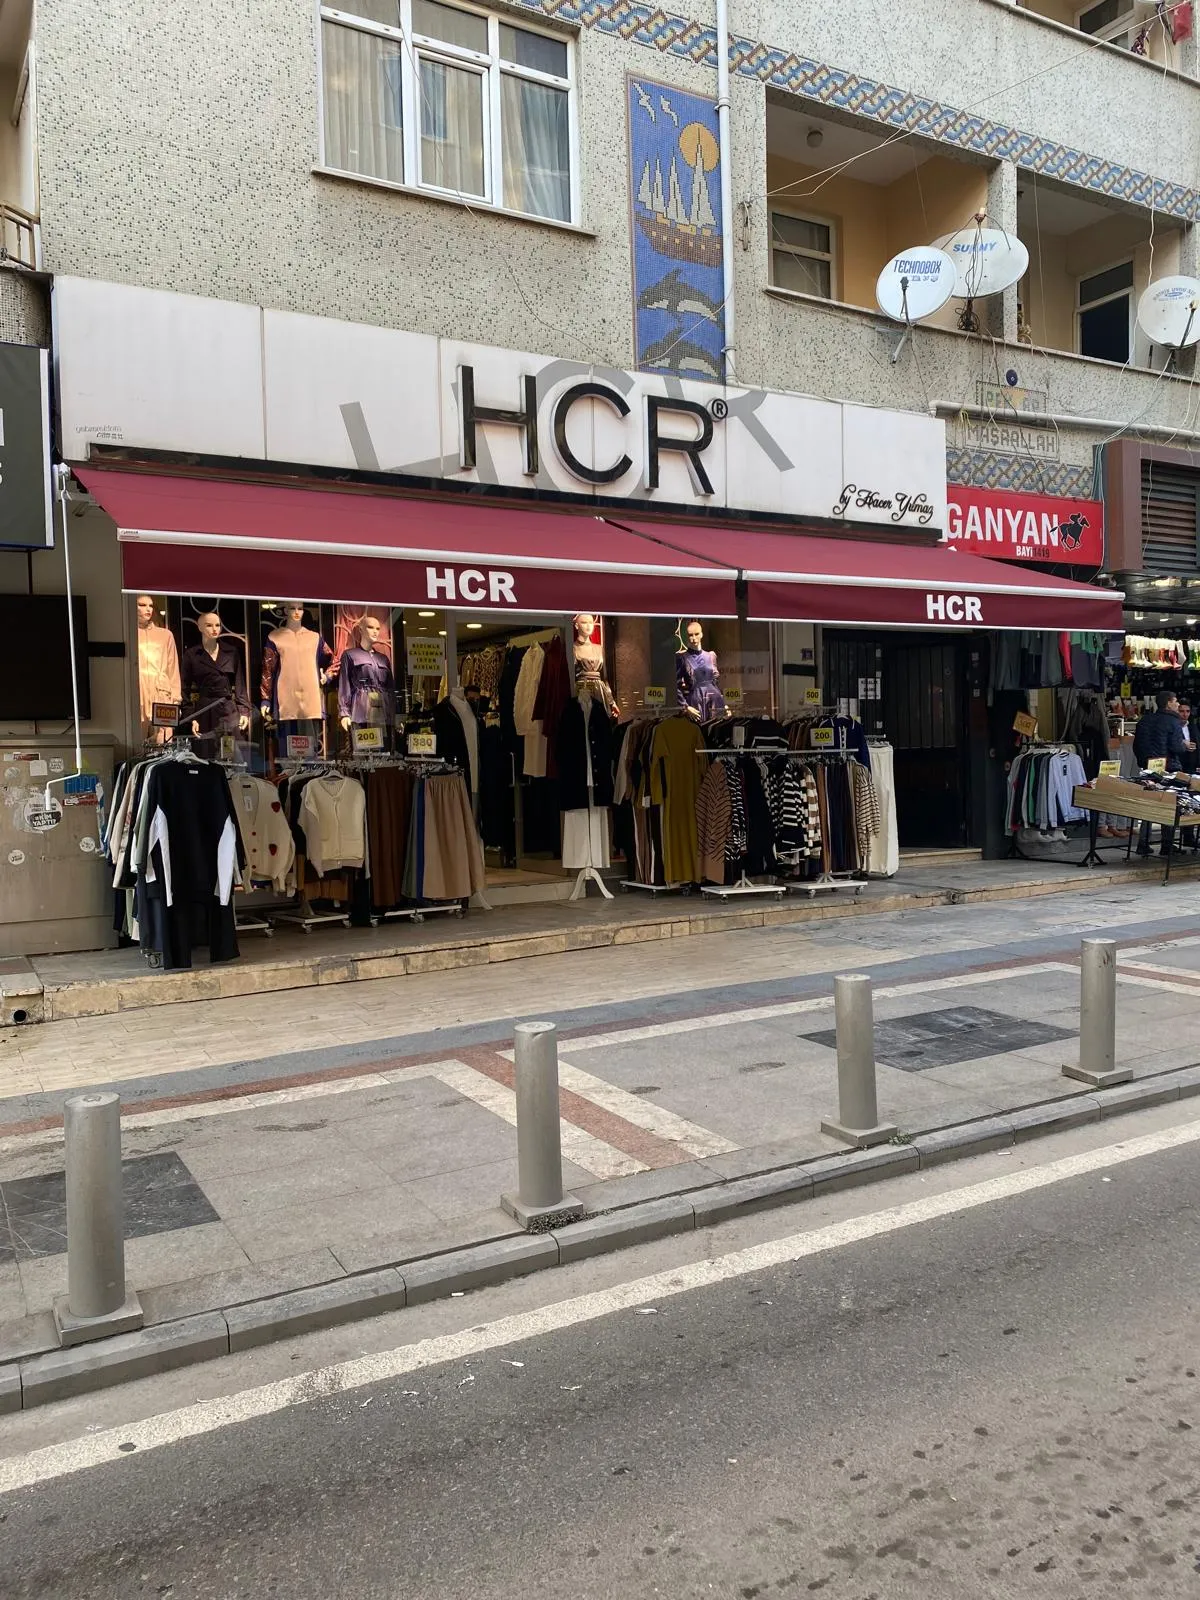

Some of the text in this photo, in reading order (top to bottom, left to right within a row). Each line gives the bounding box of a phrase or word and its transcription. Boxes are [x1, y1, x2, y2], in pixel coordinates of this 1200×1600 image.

[893, 259, 942, 275] TECHNOBOX
[832, 484, 857, 515] by
[856, 489, 893, 510] Hacer
[947, 502, 1059, 547] GANYAN
[425, 567, 518, 603] HCR
[926, 594, 984, 622] HCR
